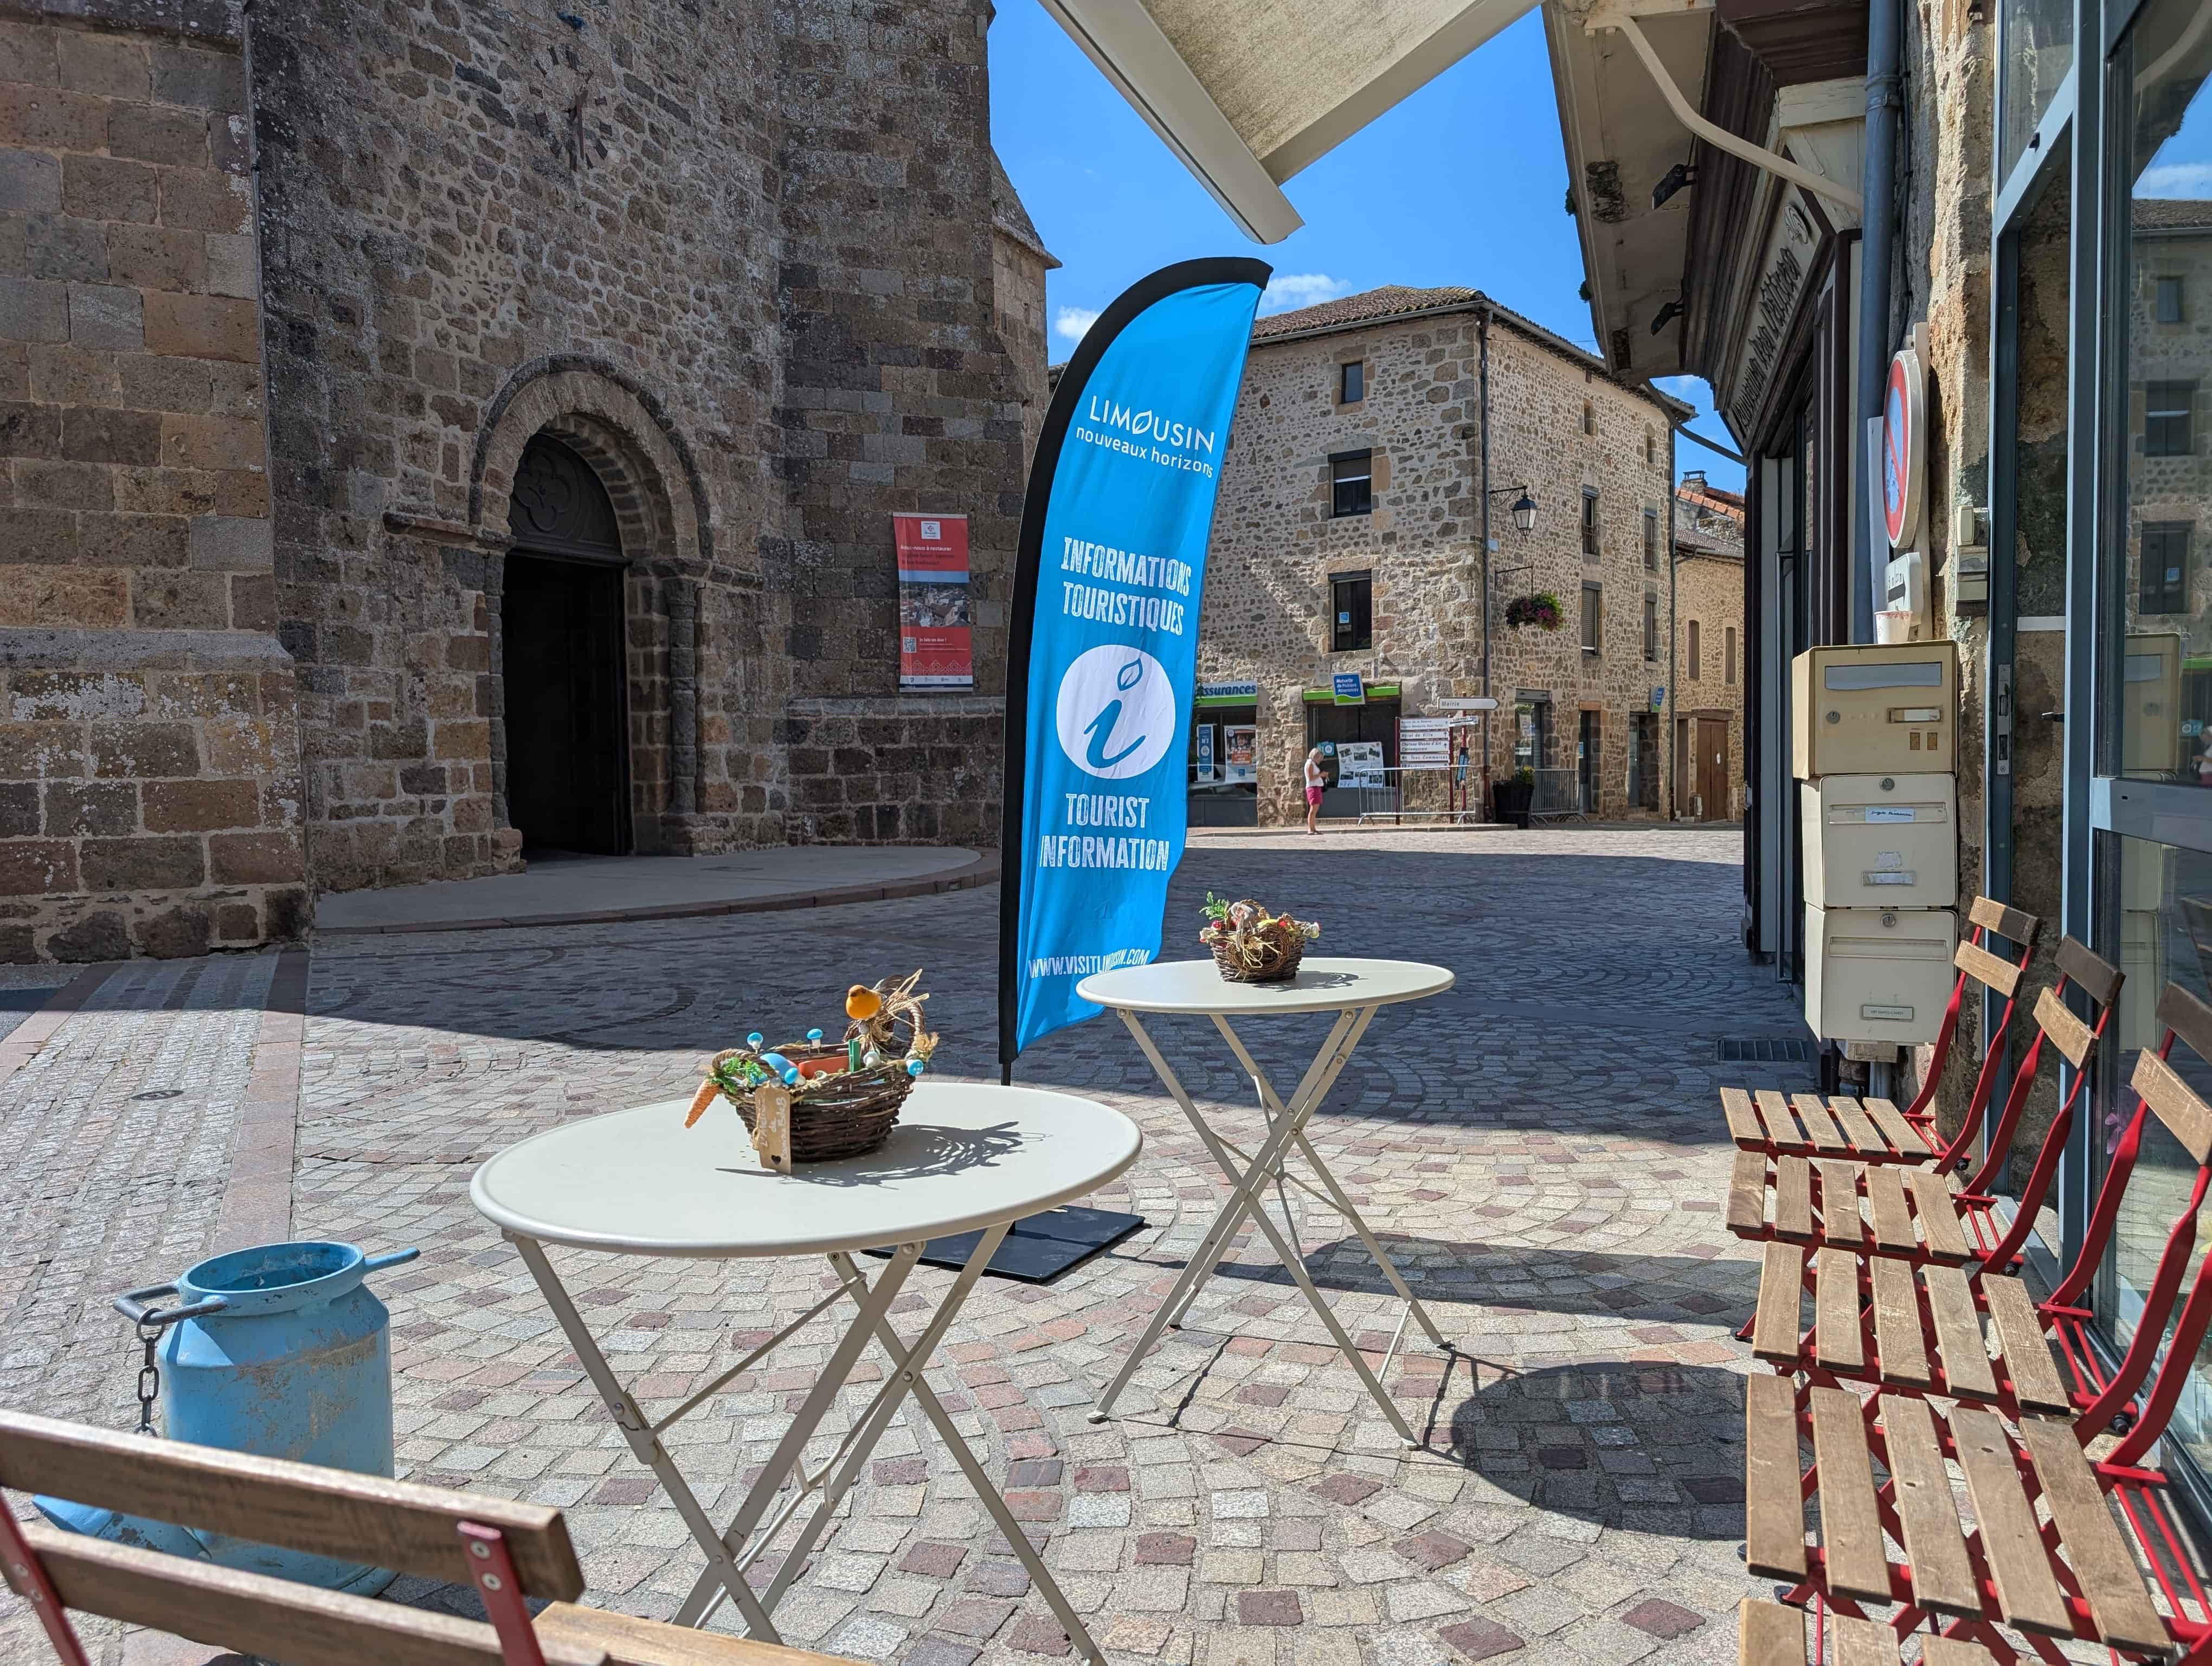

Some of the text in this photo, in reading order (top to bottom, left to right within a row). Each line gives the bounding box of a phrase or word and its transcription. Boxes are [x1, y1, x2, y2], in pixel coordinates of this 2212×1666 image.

[1090, 395, 1214, 454] LIMOUSIN
[1076, 427, 1213, 478] nouveaux horizons
[1061, 537, 1191, 597] INFORMATIONS
[1063, 581, 1184, 636] TOURISTIQUES
[1066, 793, 1149, 828] TOURIST
